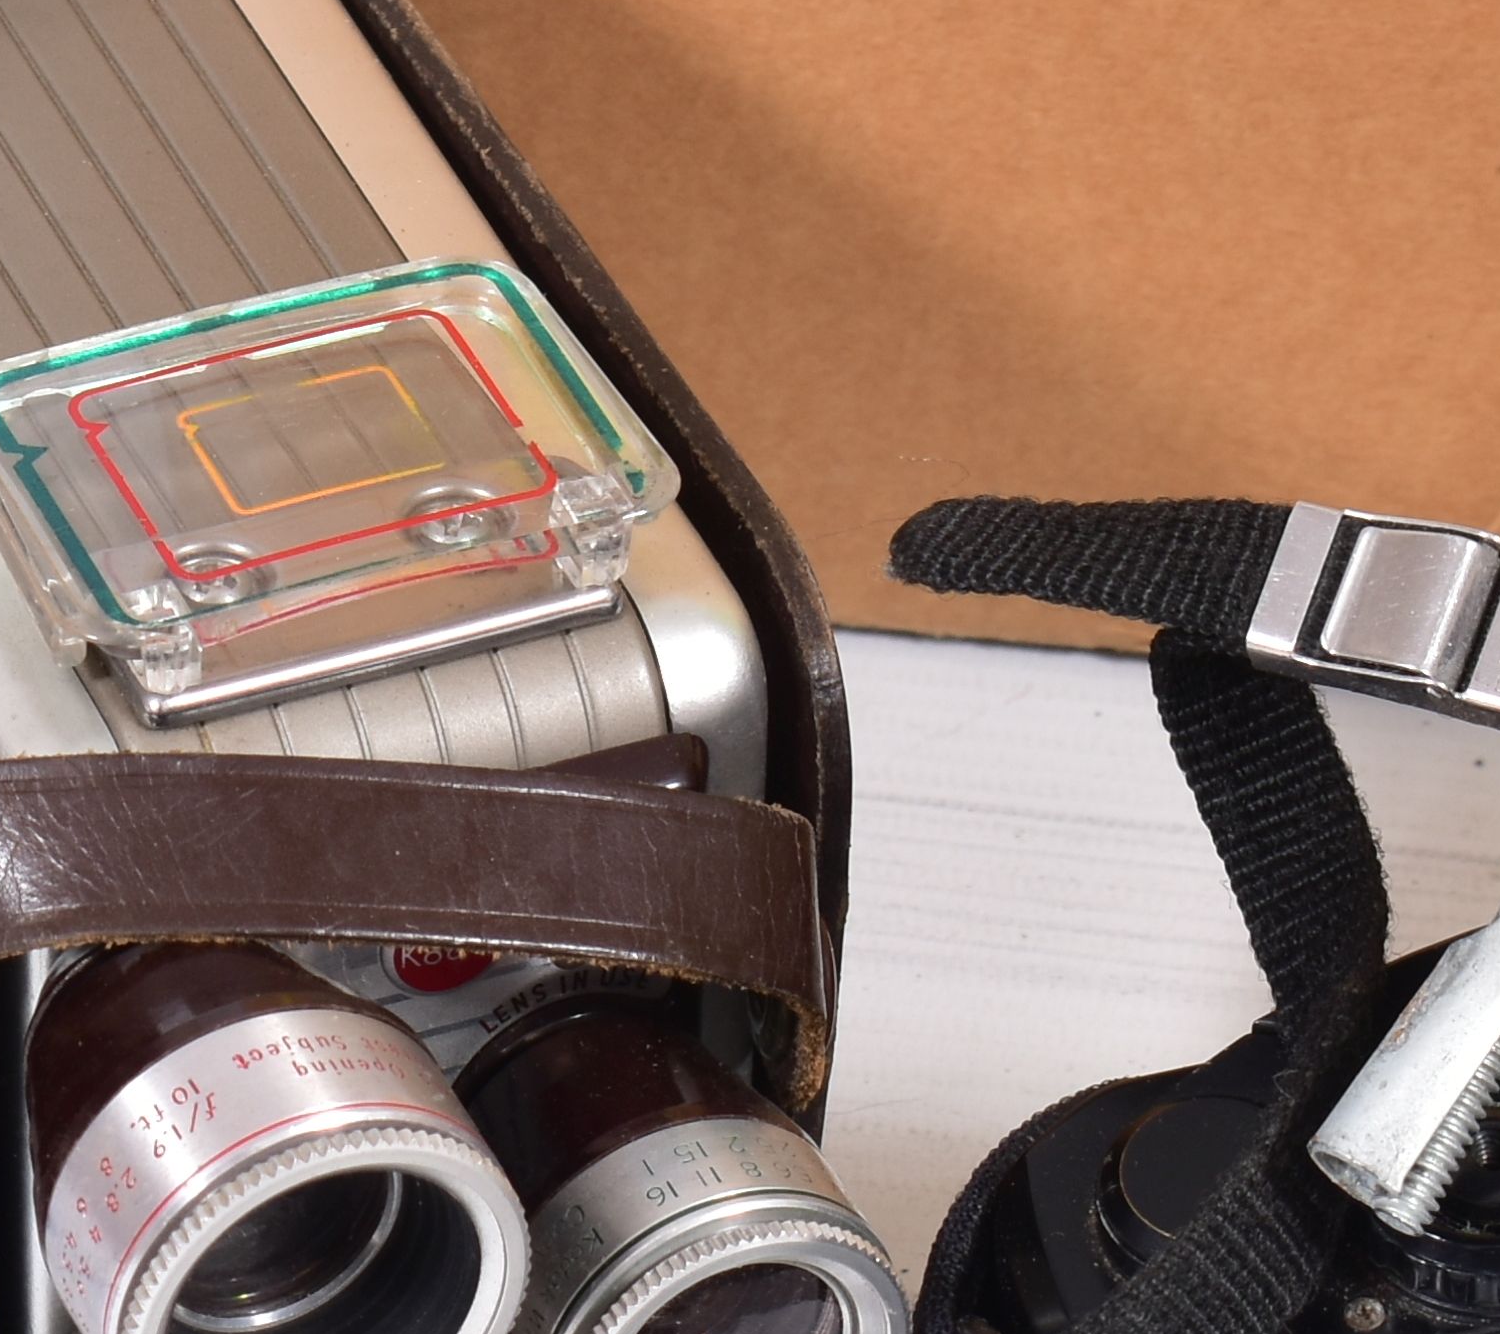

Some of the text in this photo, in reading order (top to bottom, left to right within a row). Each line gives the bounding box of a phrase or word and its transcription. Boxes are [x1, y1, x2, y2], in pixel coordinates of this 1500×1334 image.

[480, 965, 652, 1035] LENS IN USE
[231, 1033, 347, 1070] Subject
[290, 1057, 405, 1080] Opening
[169, 1077, 201, 1105] 10
[722, 1134, 746, 1154] 2
[641, 1157, 655, 1178] 1
[695, 1165, 723, 1188] 11
[739, 1160, 763, 1178] 8
[645, 1179, 680, 1208] 16
